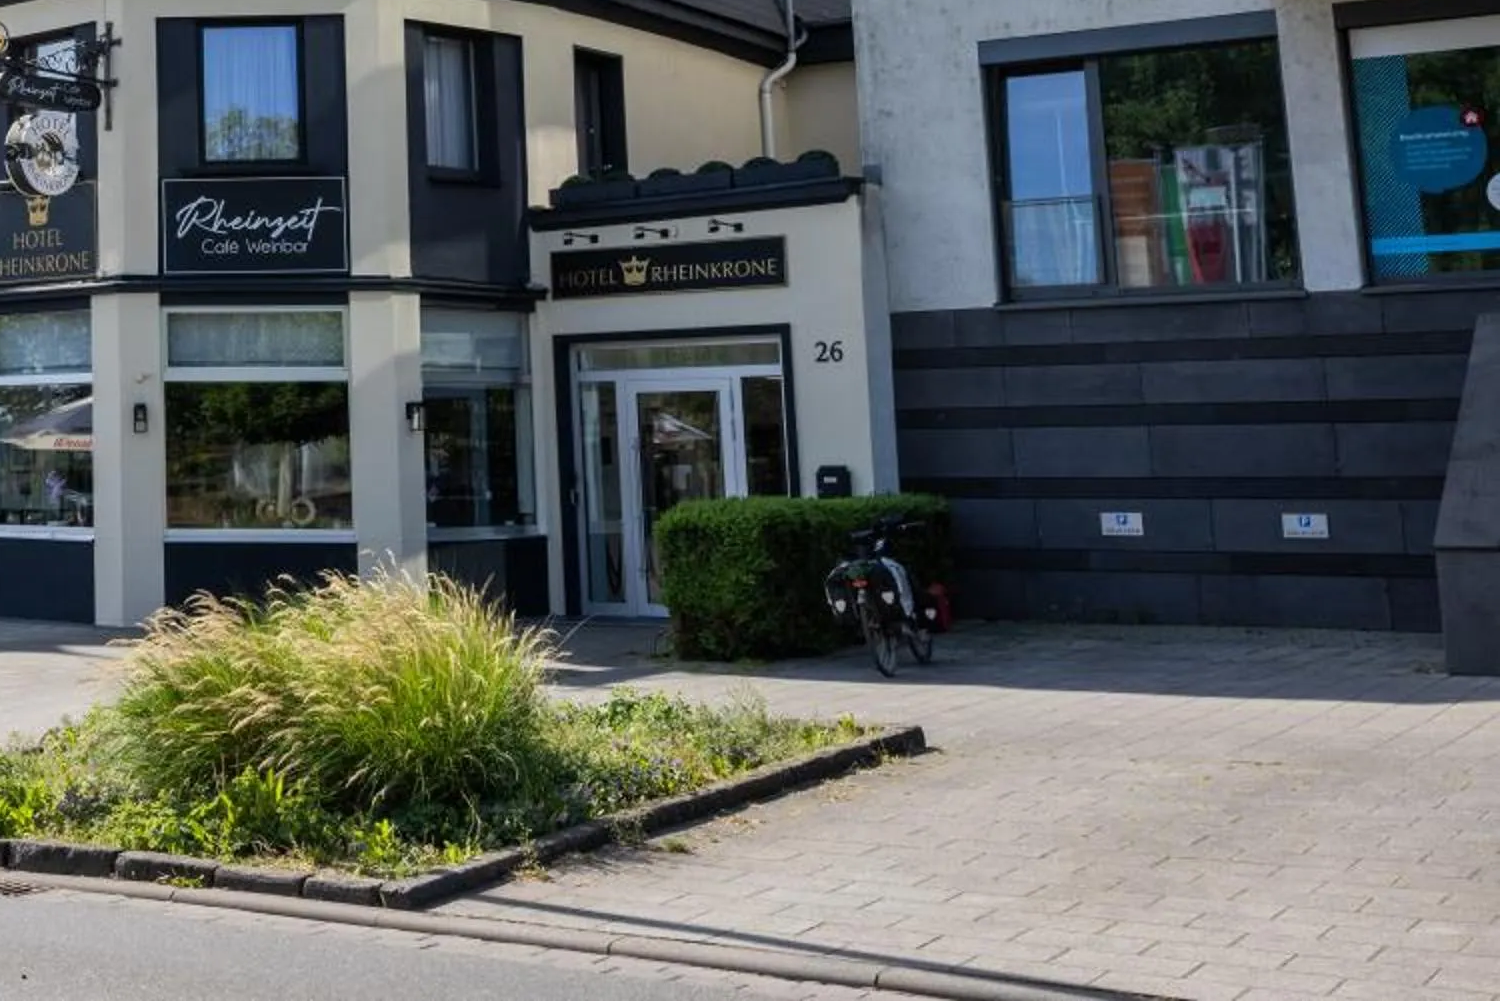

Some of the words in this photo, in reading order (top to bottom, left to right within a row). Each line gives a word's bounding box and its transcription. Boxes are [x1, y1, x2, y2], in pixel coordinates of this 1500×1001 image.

[13, 228, 64, 249] HOTEL
[246, 238, 308, 254] Weinbar
[559, 267, 619, 289] HOTEL
[651, 257, 779, 283] RHEINKRONE
[814, 340, 843, 362] 26
